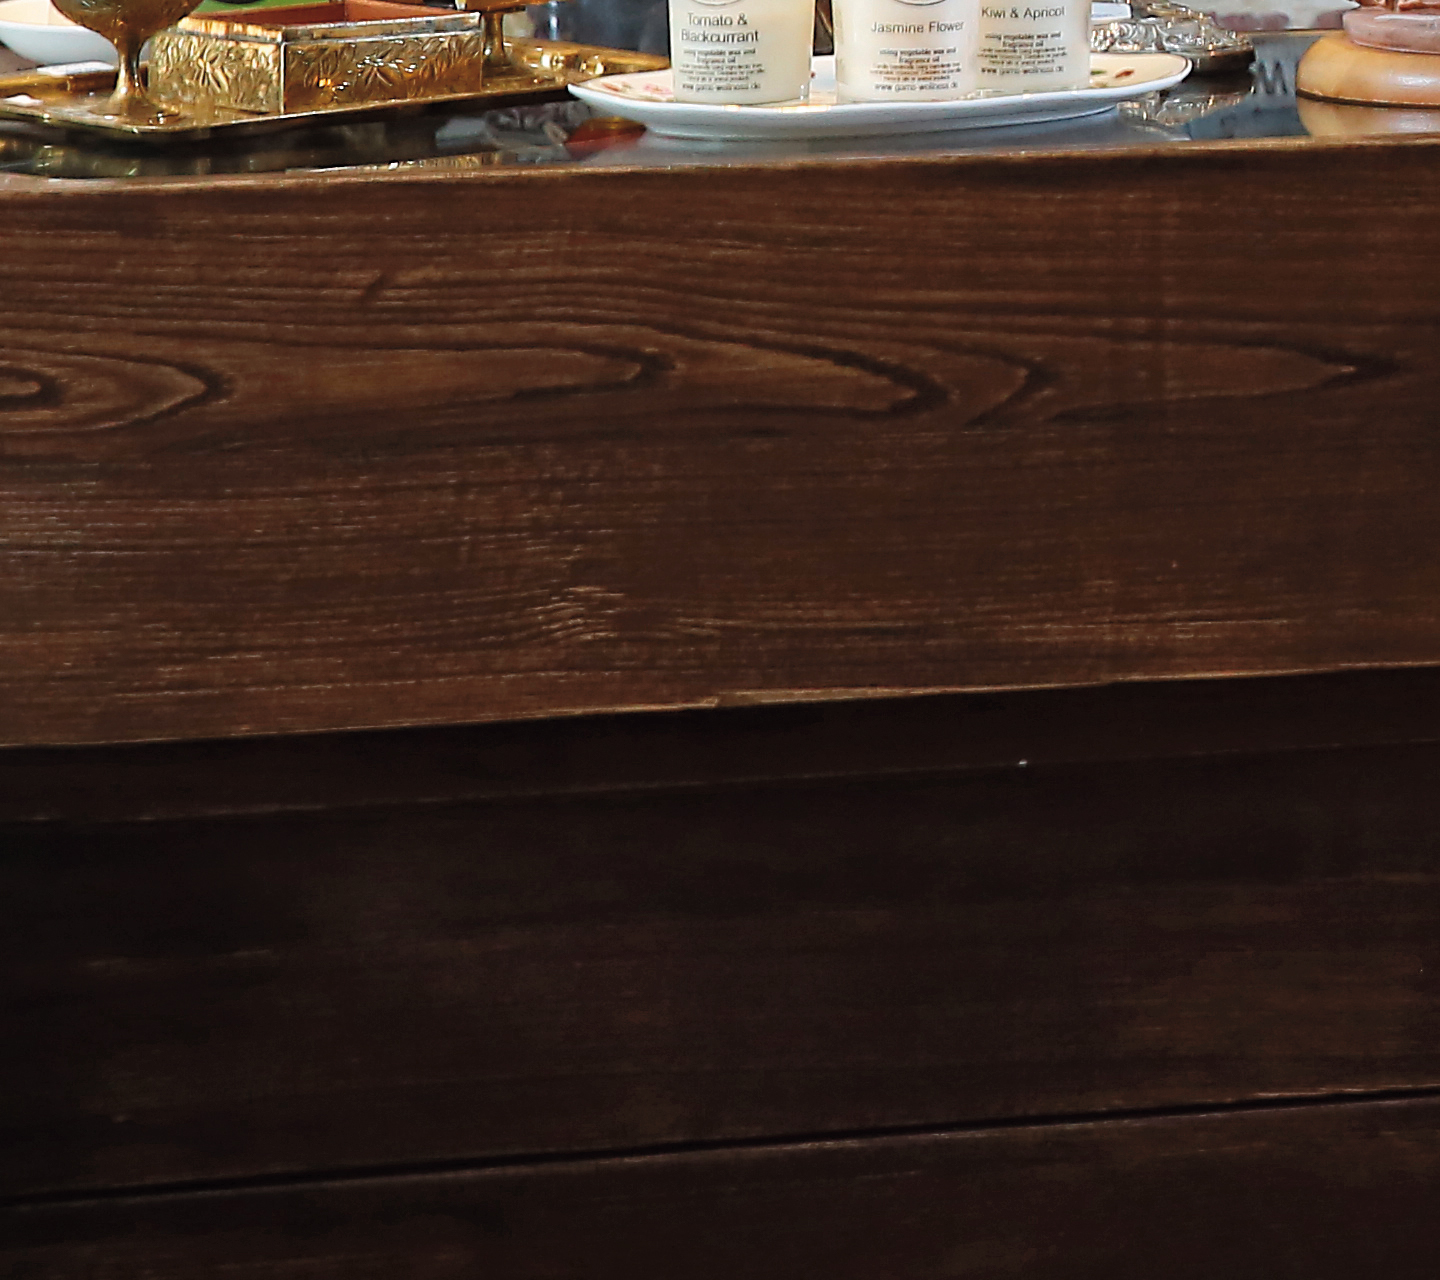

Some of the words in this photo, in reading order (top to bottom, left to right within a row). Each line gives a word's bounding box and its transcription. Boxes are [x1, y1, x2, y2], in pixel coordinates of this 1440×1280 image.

[687, 12, 733, 26] Tomato
[737, 13, 748, 26] &
[981, 6, 1006, 19] Kiwi
[1010, 7, 1019, 19] &
[1023, 6, 1065, 21] Apricot
[871, 21, 924, 34] Jasmine
[928, 20, 965, 33] Flower
[681, 29, 759, 43] Blackcurrant
